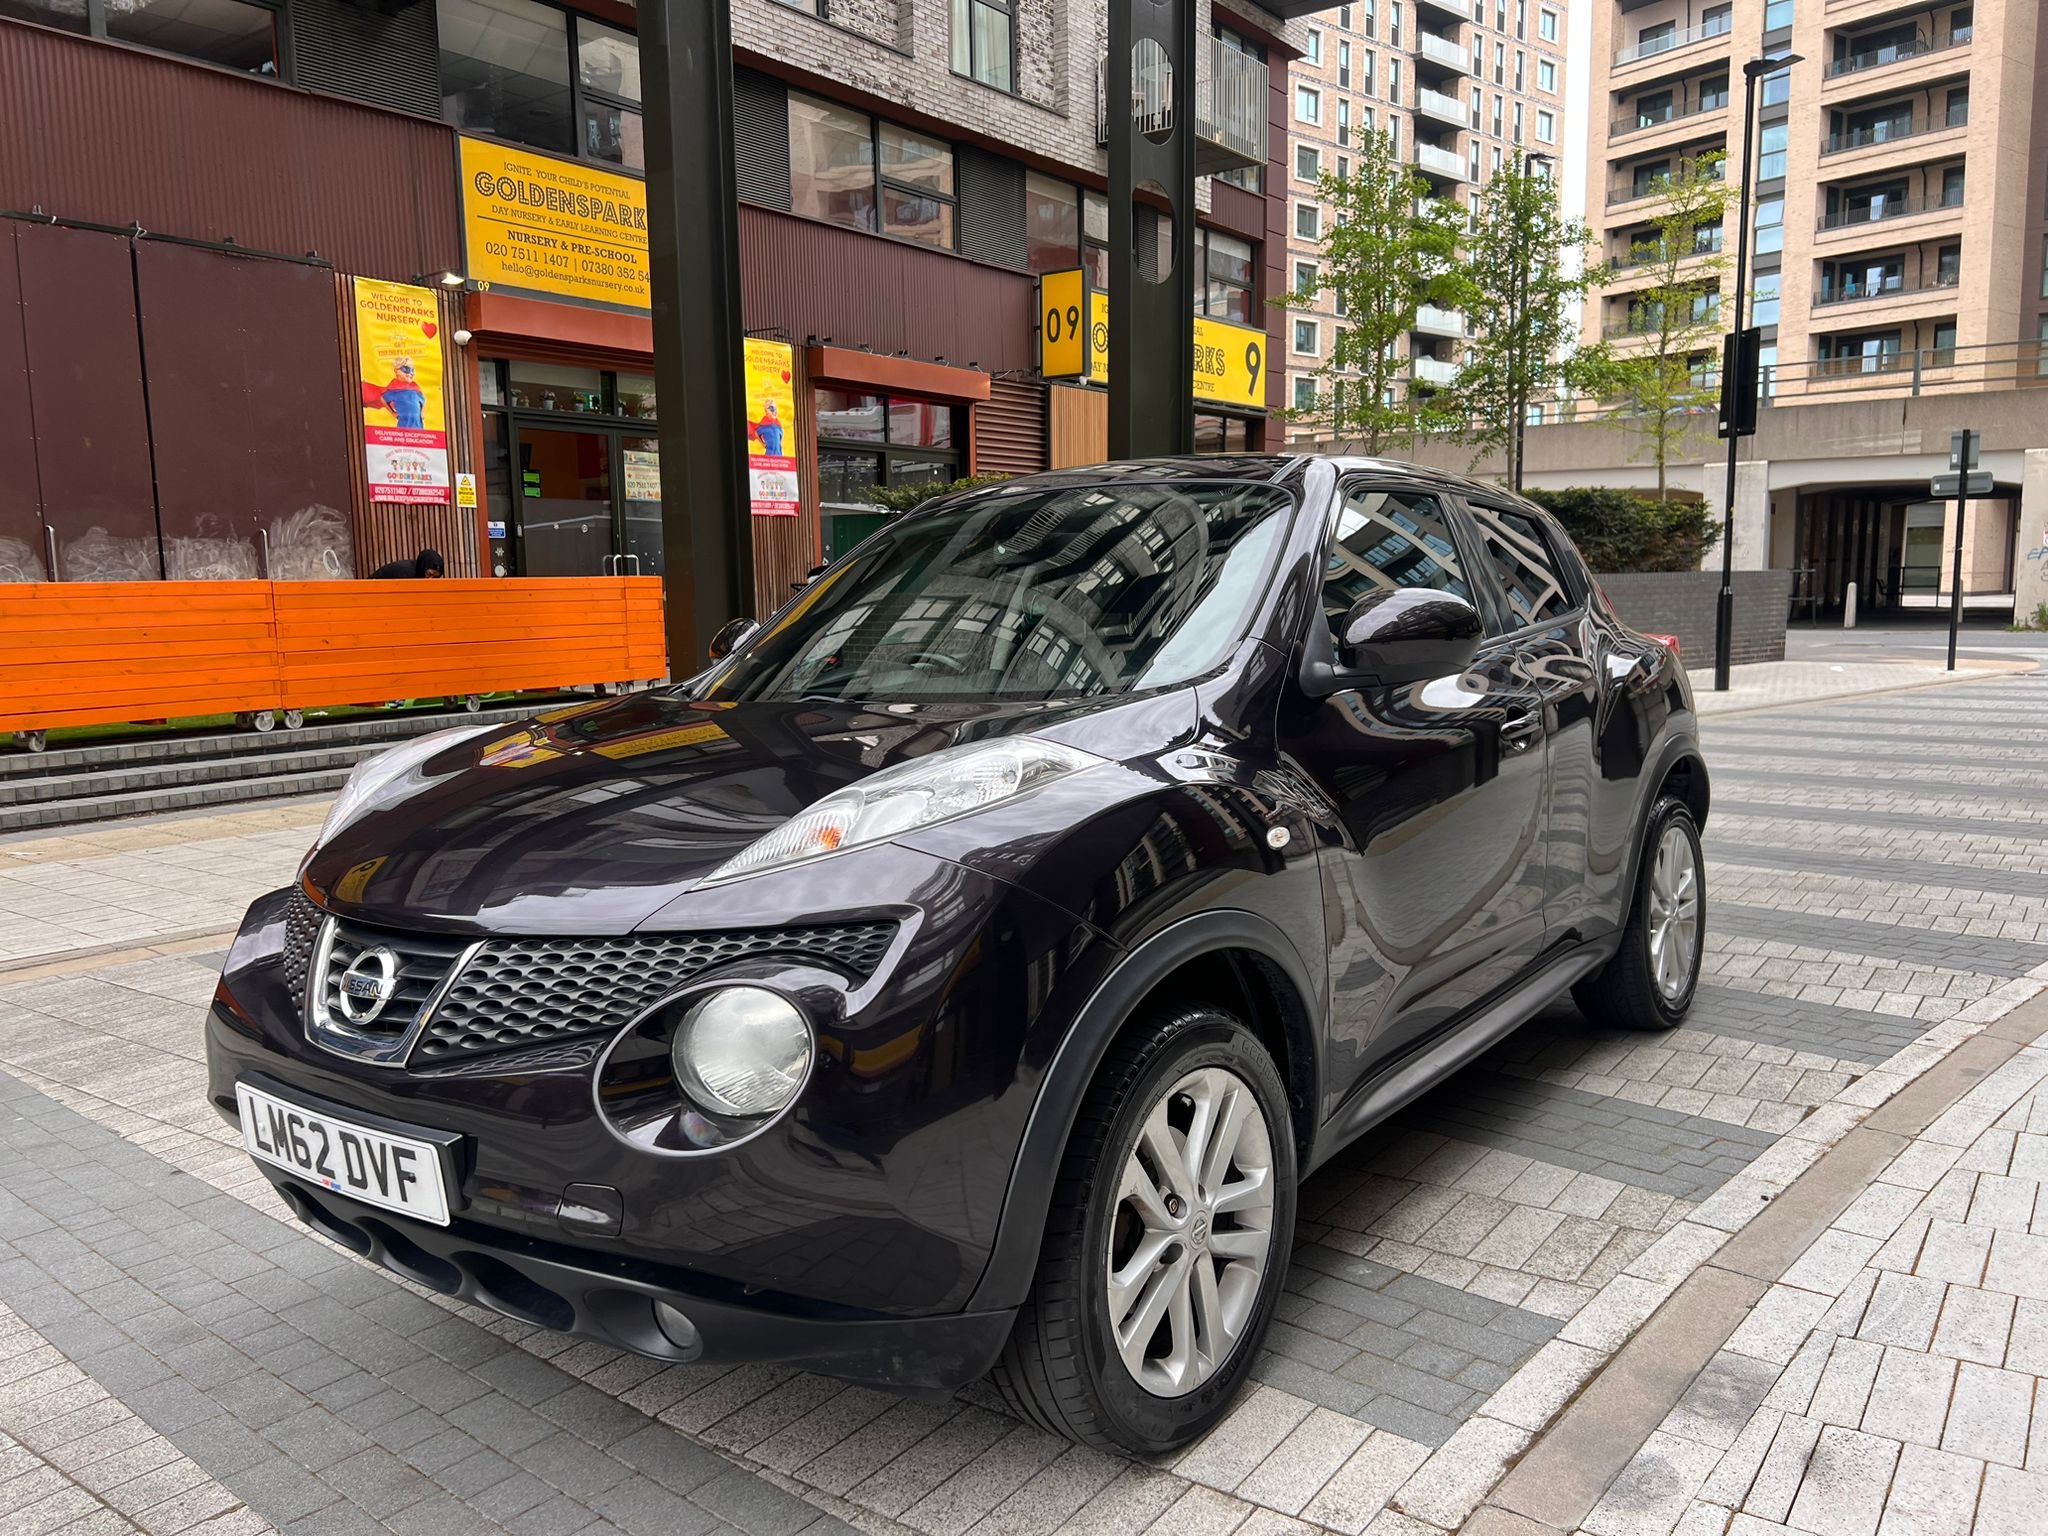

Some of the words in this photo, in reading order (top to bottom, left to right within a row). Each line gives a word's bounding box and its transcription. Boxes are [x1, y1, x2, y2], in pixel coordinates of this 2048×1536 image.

[503, 162, 532, 176] IGNITE
[536, 169, 558, 183] YOUR
[559, 175, 589, 190] CHILD'S
[590, 183, 631, 199] POTENTIAL
[475, 171, 647, 230] GOLDENSPARK
[492, 204, 509, 216] DAY
[511, 208, 547, 224] NURSERY
[548, 217, 555, 226] &
[555, 218, 579, 231] EARLY
[580, 223, 618, 239] LEARNING
[619, 231, 648, 245] CENTRE
[485, 241, 508, 257] 020
[511, 246, 539, 263] 7511
[543, 252, 569, 268] 1407
[581, 259, 614, 276] 07380
[617, 266, 636, 280] 352
[638, 270, 651, 283] 54
[507, 230, 558, 249] NURSERY
[560, 240, 569, 251] &
[571, 242, 638, 264] PRE-SCHOOL
[478, 281, 490, 292] 09
[501, 261, 645, 294] hello@goldensparksnursery.co.uk
[360, 300, 435, 318] GOLDENSPARKS
[371, 292, 411, 305] WELCOME
[413, 299, 422, 307] TO
[376, 312, 420, 326] NURSERY
[1047, 305, 1080, 343] 09
[1245, 342, 1261, 397] 9
[248, 1096, 336, 1179] LM62
[338, 1130, 417, 1203] DVF
